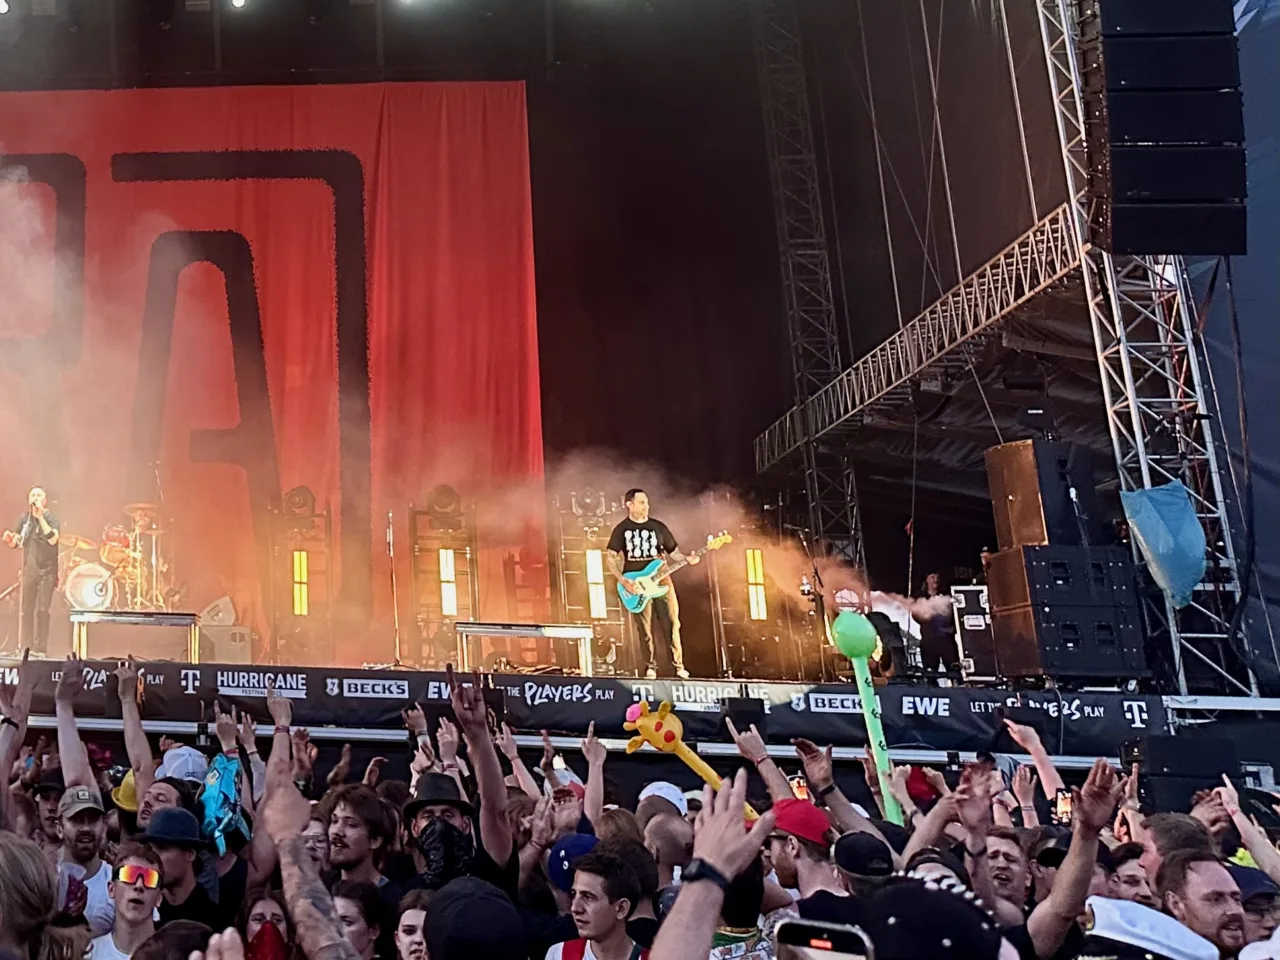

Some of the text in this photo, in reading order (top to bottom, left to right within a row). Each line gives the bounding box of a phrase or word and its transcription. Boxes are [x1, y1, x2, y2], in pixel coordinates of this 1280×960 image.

[147, 674, 165, 685] PLAY
[217, 671, 307, 689] HURRICANE
[347, 681, 406, 695] BECK'S
[507, 686, 520, 697] THE
[524, 682, 593, 705] PLAYERS
[595, 689, 615, 700] PLAY
[902, 696, 950, 716] EWE
[970, 701, 985, 713] LET
[1084, 705, 1104, 718] PLAY
